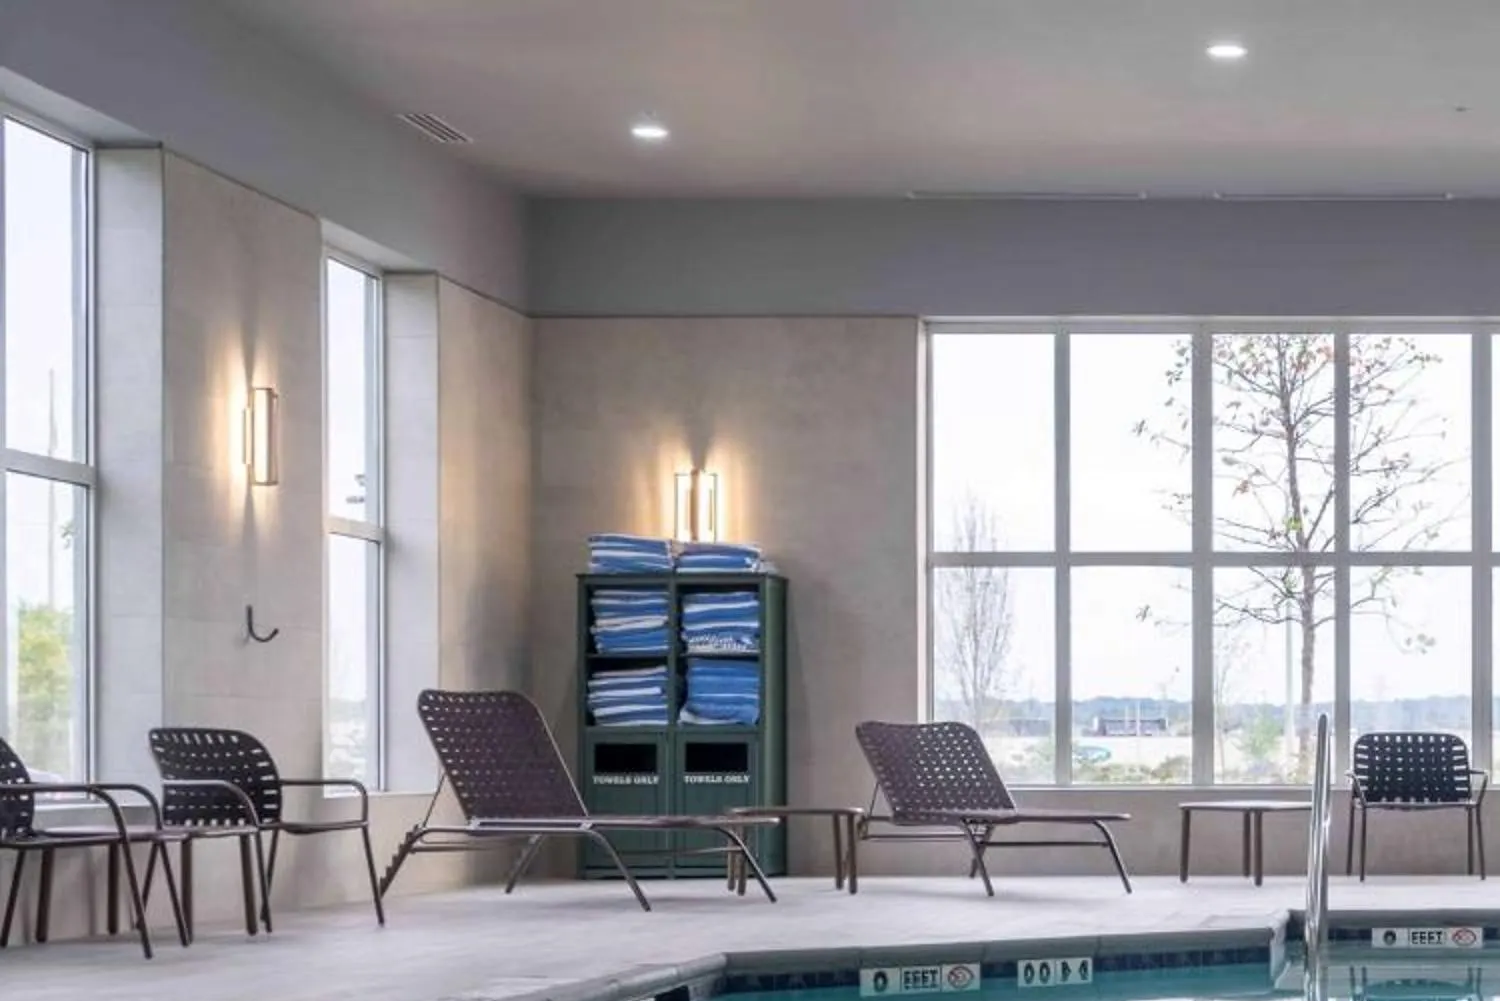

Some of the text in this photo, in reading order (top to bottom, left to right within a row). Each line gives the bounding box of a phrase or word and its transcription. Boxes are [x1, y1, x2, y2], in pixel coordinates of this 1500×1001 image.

[592, 775, 659, 785] TOWELS ONLY
[683, 775, 750, 785] TOWELS ONLY
